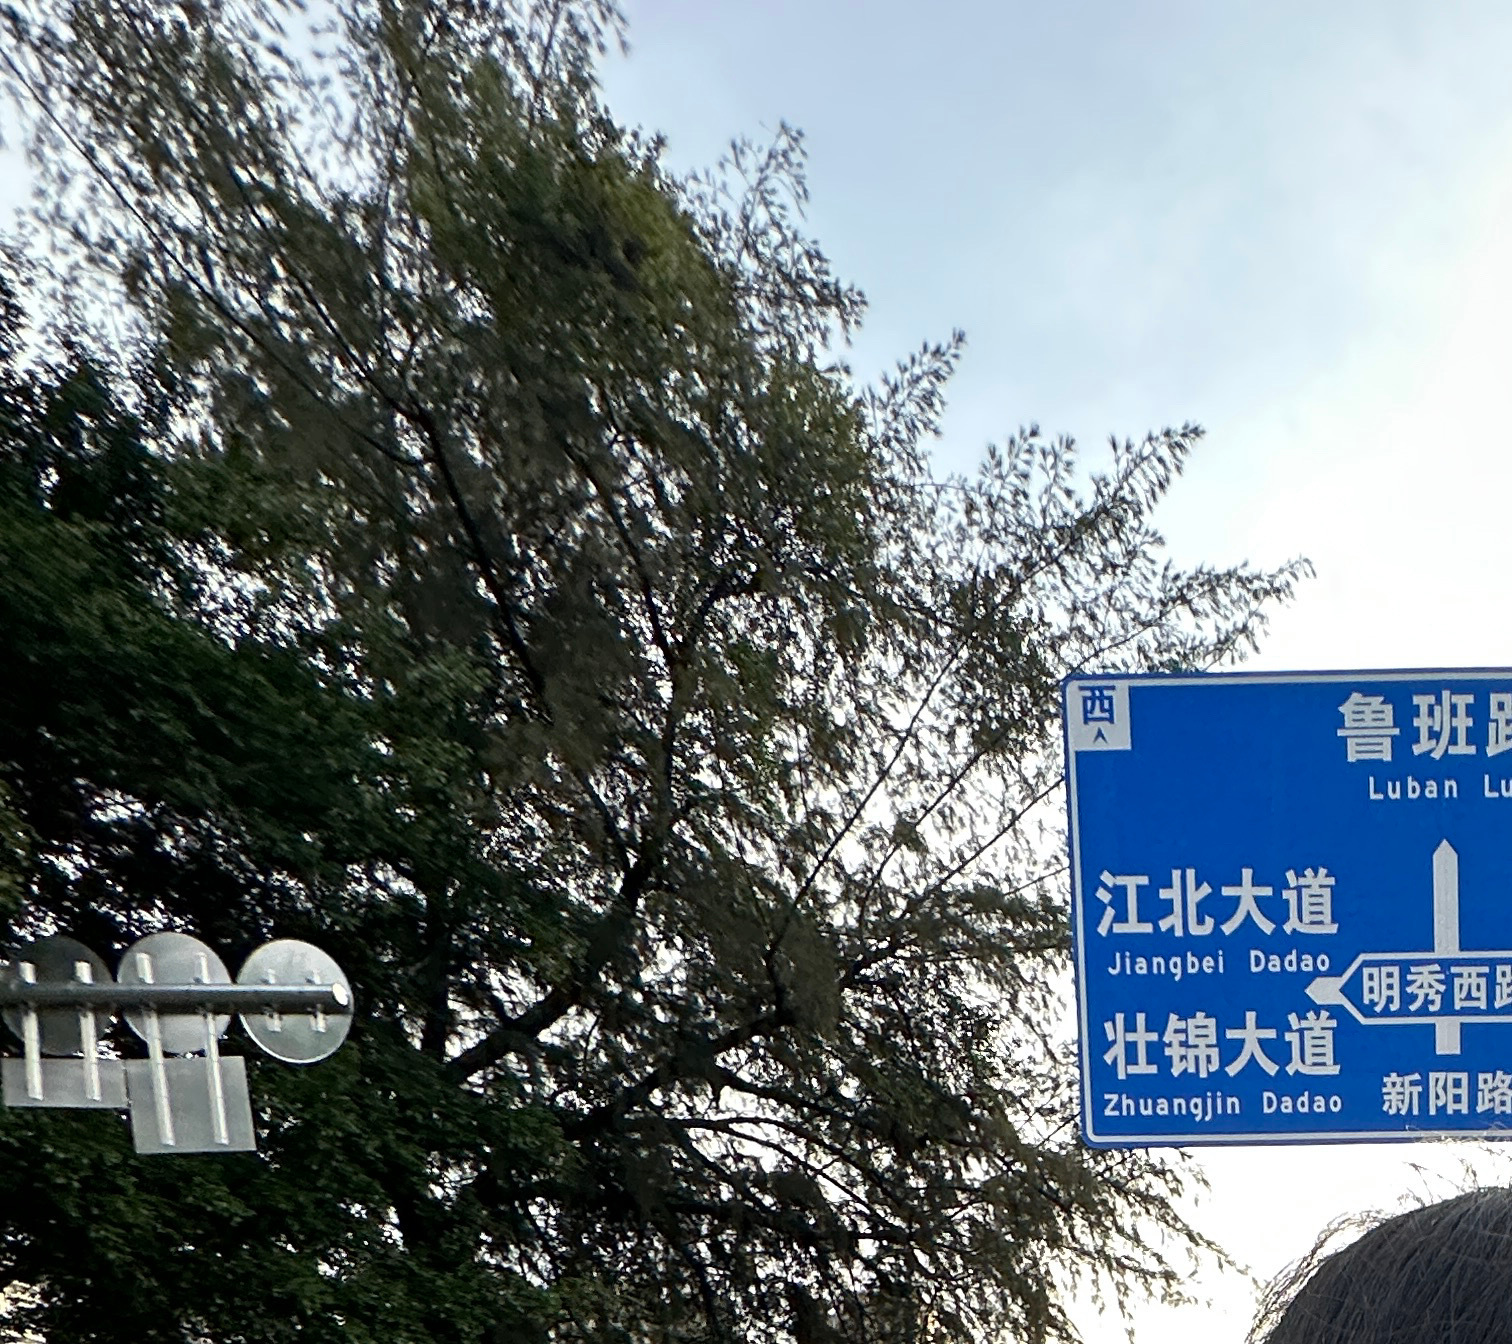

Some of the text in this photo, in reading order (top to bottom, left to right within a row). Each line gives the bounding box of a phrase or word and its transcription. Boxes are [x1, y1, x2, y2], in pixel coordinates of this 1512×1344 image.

[1080, 687, 1116, 725] 西
[1369, 775, 1457, 800] Luban
[1096, 868, 1338, 936] 江北大道
[1108, 949, 1330, 977] Jiangbei Dadao
[1104, 1011, 1340, 1079] 壮锦大道
[1104, 1091, 1341, 1122] Zhuangjin Dadao
